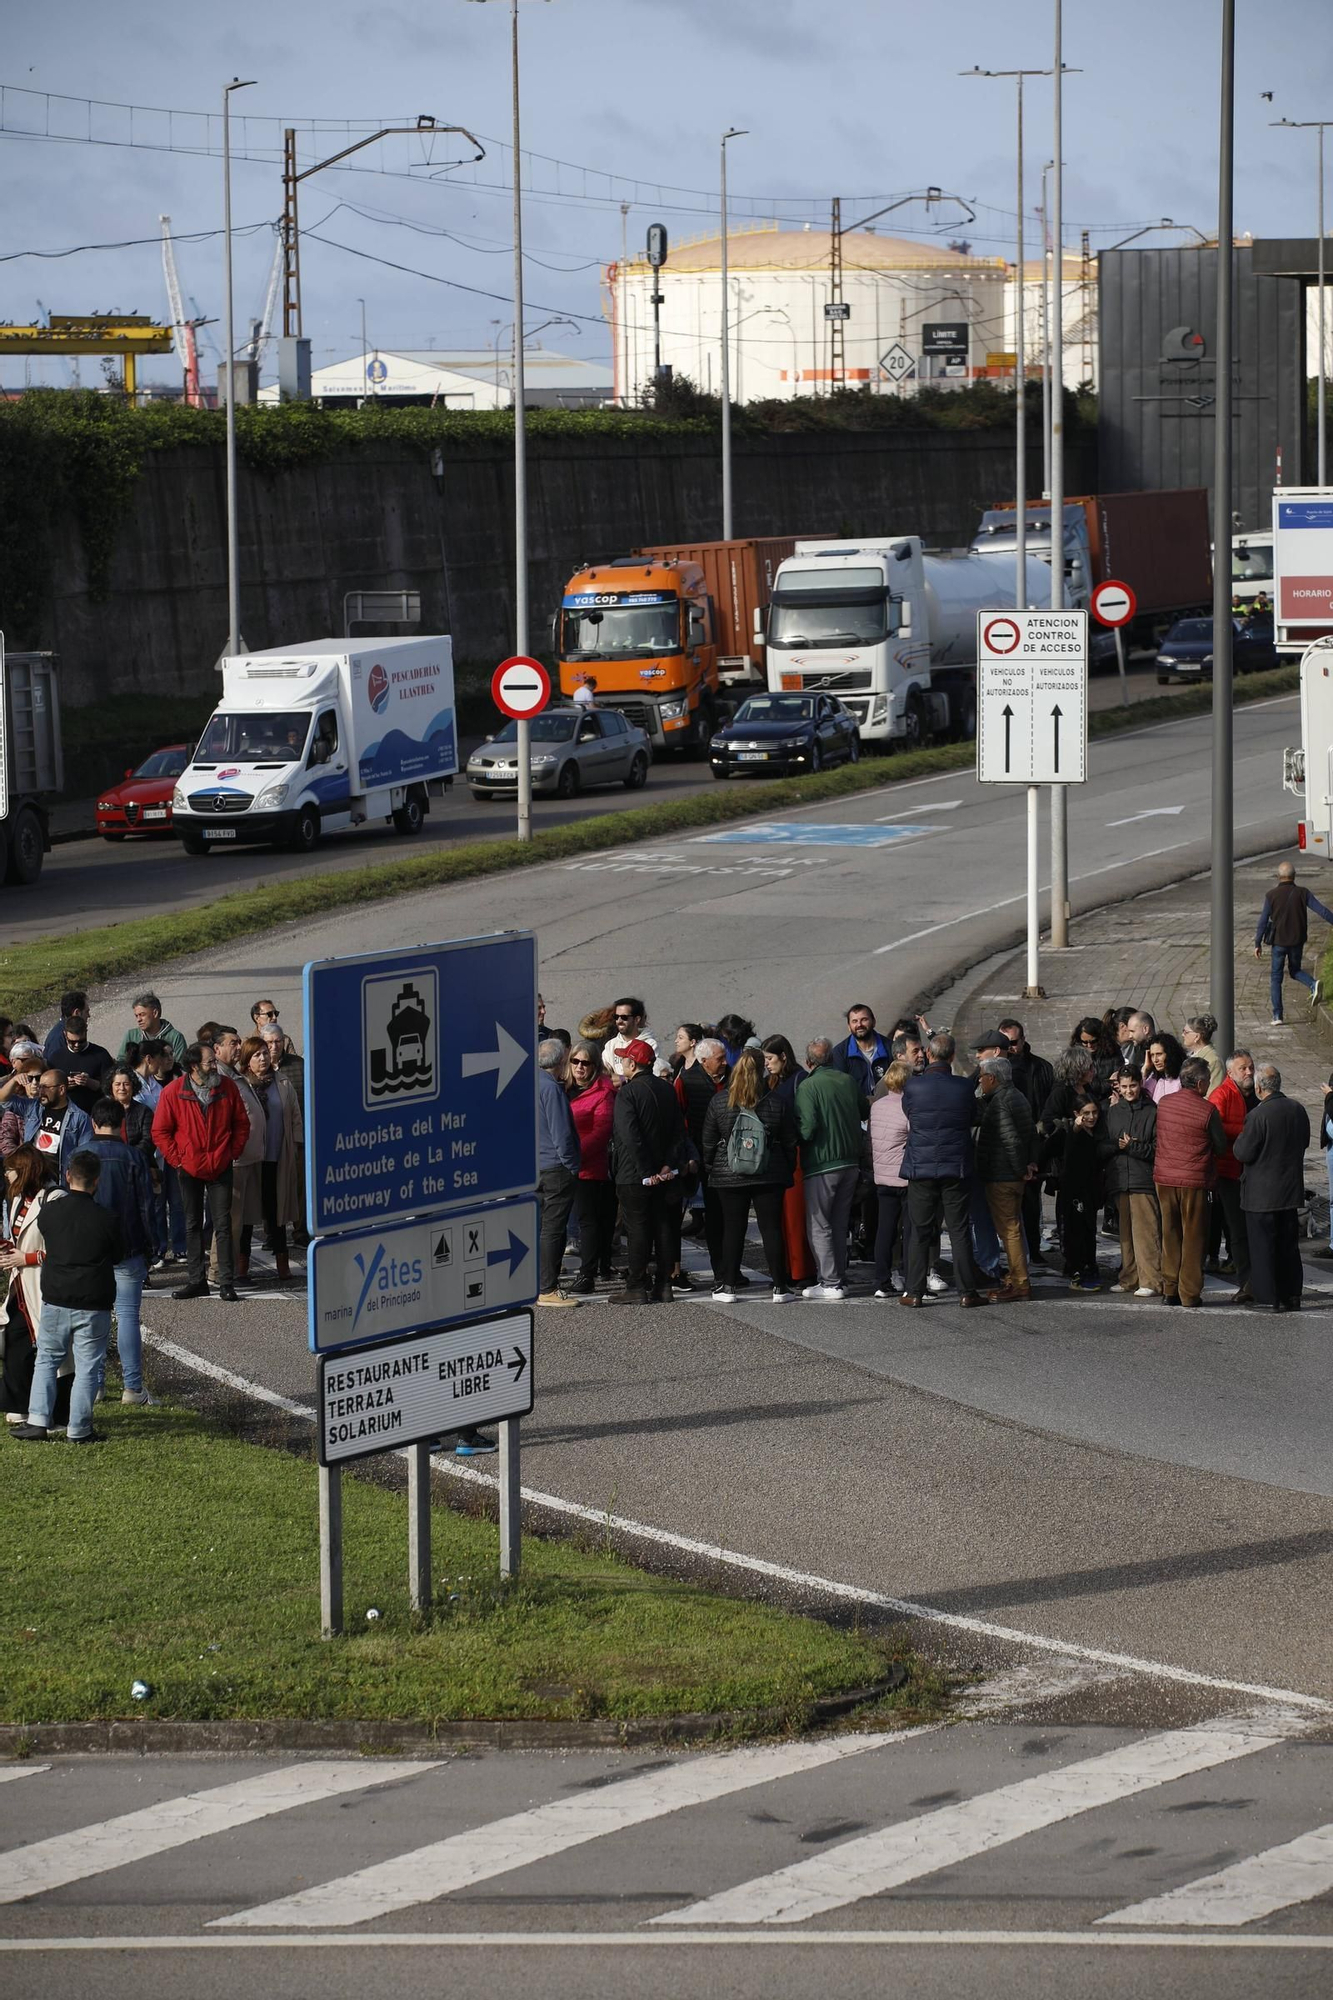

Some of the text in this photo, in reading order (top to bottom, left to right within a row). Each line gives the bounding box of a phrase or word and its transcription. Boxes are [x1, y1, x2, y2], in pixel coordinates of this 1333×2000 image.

[889, 356, 905, 370] 20
[1292, 589, 1332, 598] HORARIO
[574, 595, 618, 605] vascop
[1027, 618, 1079, 628] ATENCION
[1028, 631, 1077, 640] CONTROL
[1023, 643, 1082, 653] DE ACCESO
[391, 663, 441, 684] PESCADERÍAS
[639, 668, 666, 677] vascop
[990, 668, 1026, 676] VEHICULOS
[1039, 668, 1075, 676] VEHICULOS
[1002, 678, 1013, 686] NO
[1036, 682, 1079, 691] AUTORIZADOS
[399, 683, 435, 700] LLASTRES
[986, 688, 1029, 697] AUTORIZADOS
[607, 853, 829, 865] DEL MAR
[565, 862, 793, 876] AUTOPISTA
[335, 1112, 467, 1152] Autopista del Mar
[325, 1140, 477, 1184] Autoroute de La Mer
[323, 1170, 479, 1215] Motorway of the Sea
[324, 1288, 421, 1322] marina del Principado
[327, 1349, 504, 1394] RESTAURANTE ENTRADA
[328, 1373, 491, 1419] TERRAZA LIBRE
[328, 1410, 402, 1445] SOLARIUM
